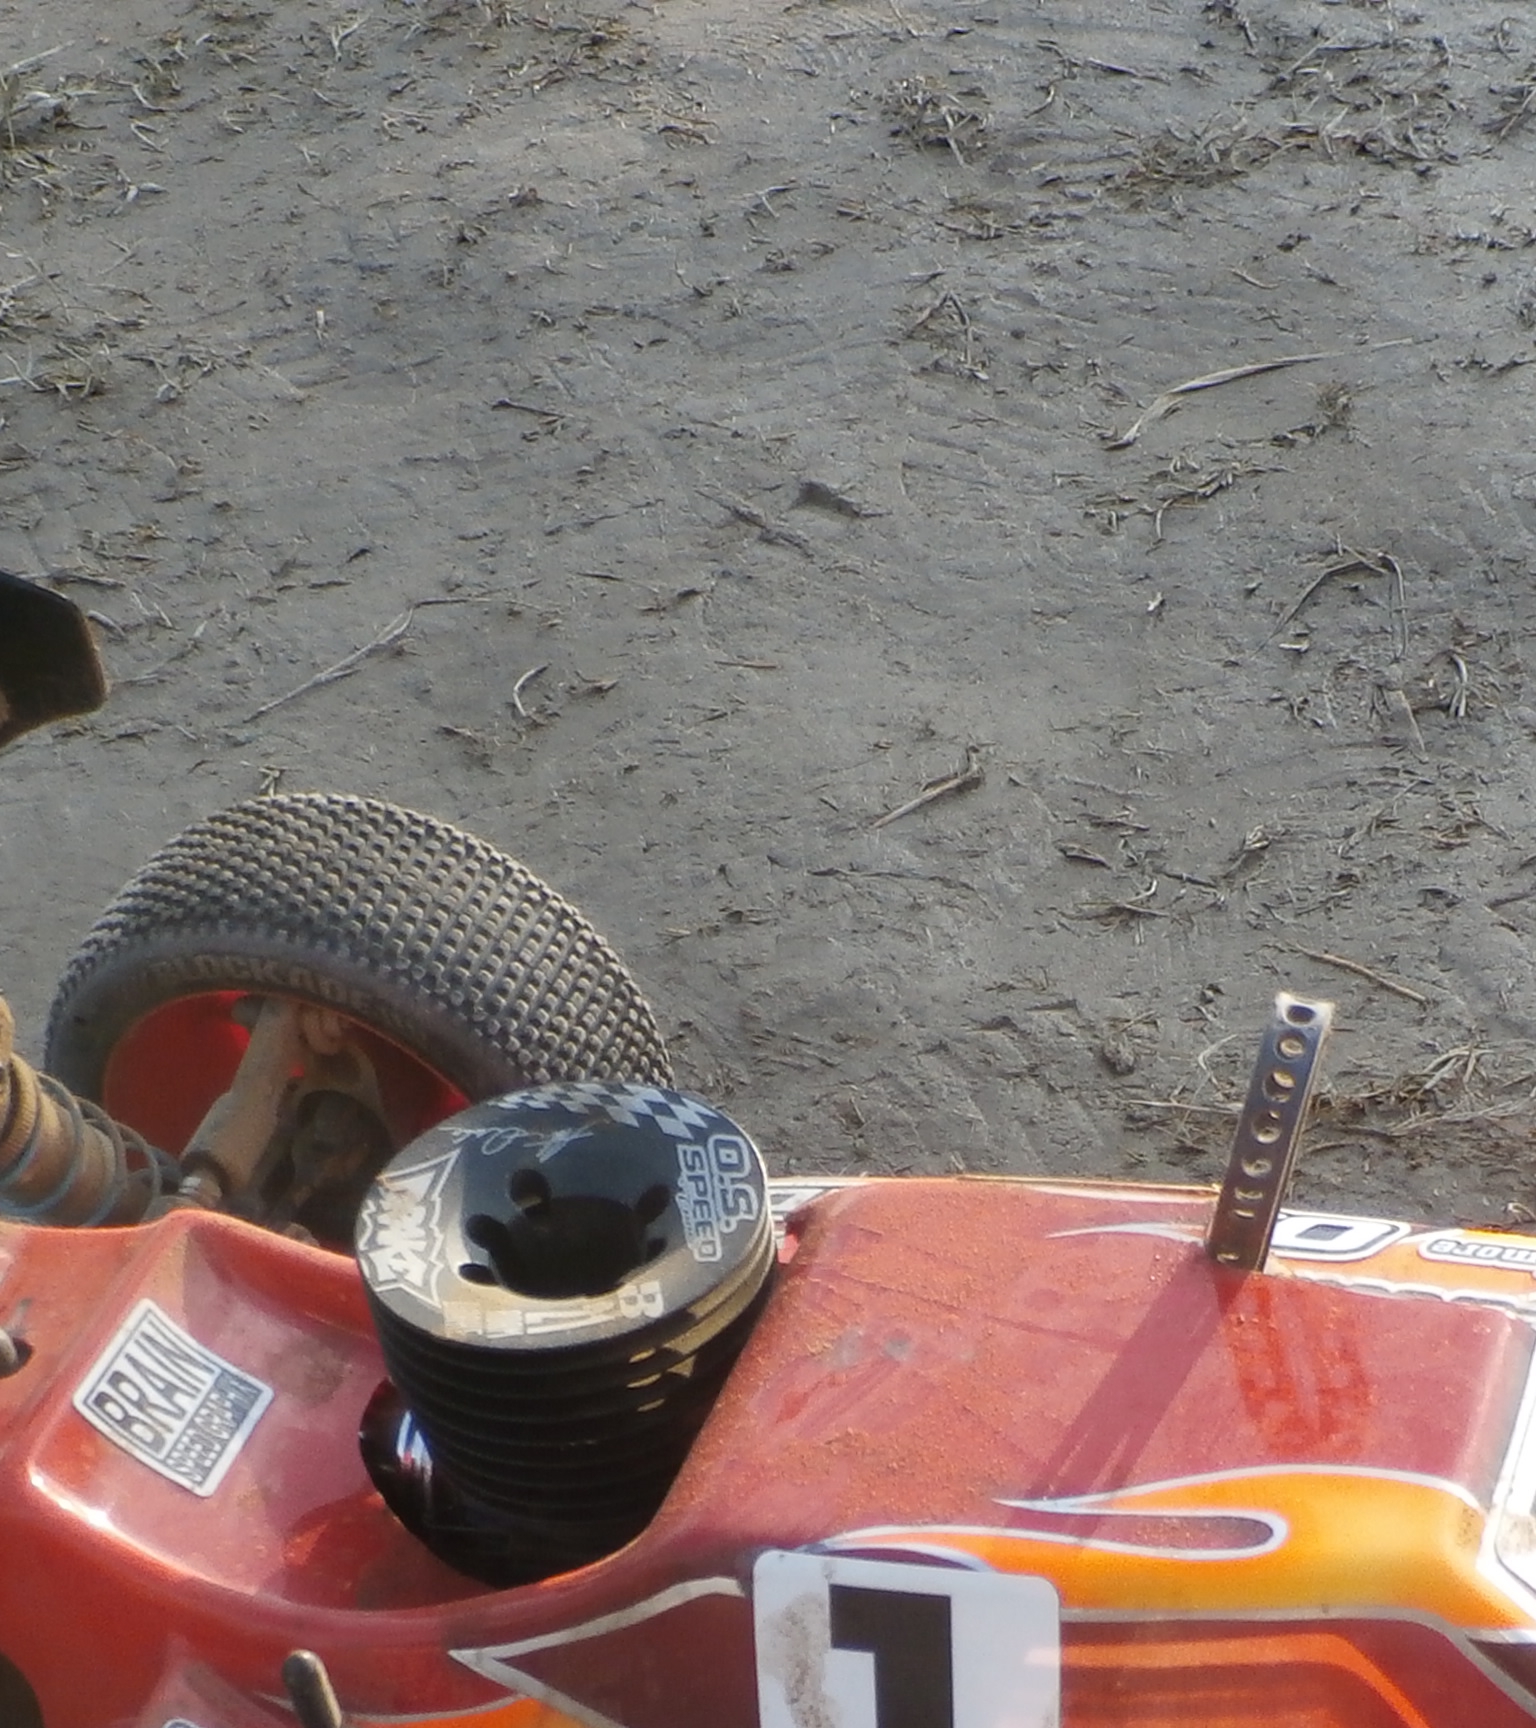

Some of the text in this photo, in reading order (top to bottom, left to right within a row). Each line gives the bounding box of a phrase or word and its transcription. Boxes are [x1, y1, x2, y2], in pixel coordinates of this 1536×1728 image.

[680, 1147, 720, 1259] SPEED
[710, 1136, 757, 1231] O.S.
[90, 1317, 216, 1454] BRAIN
